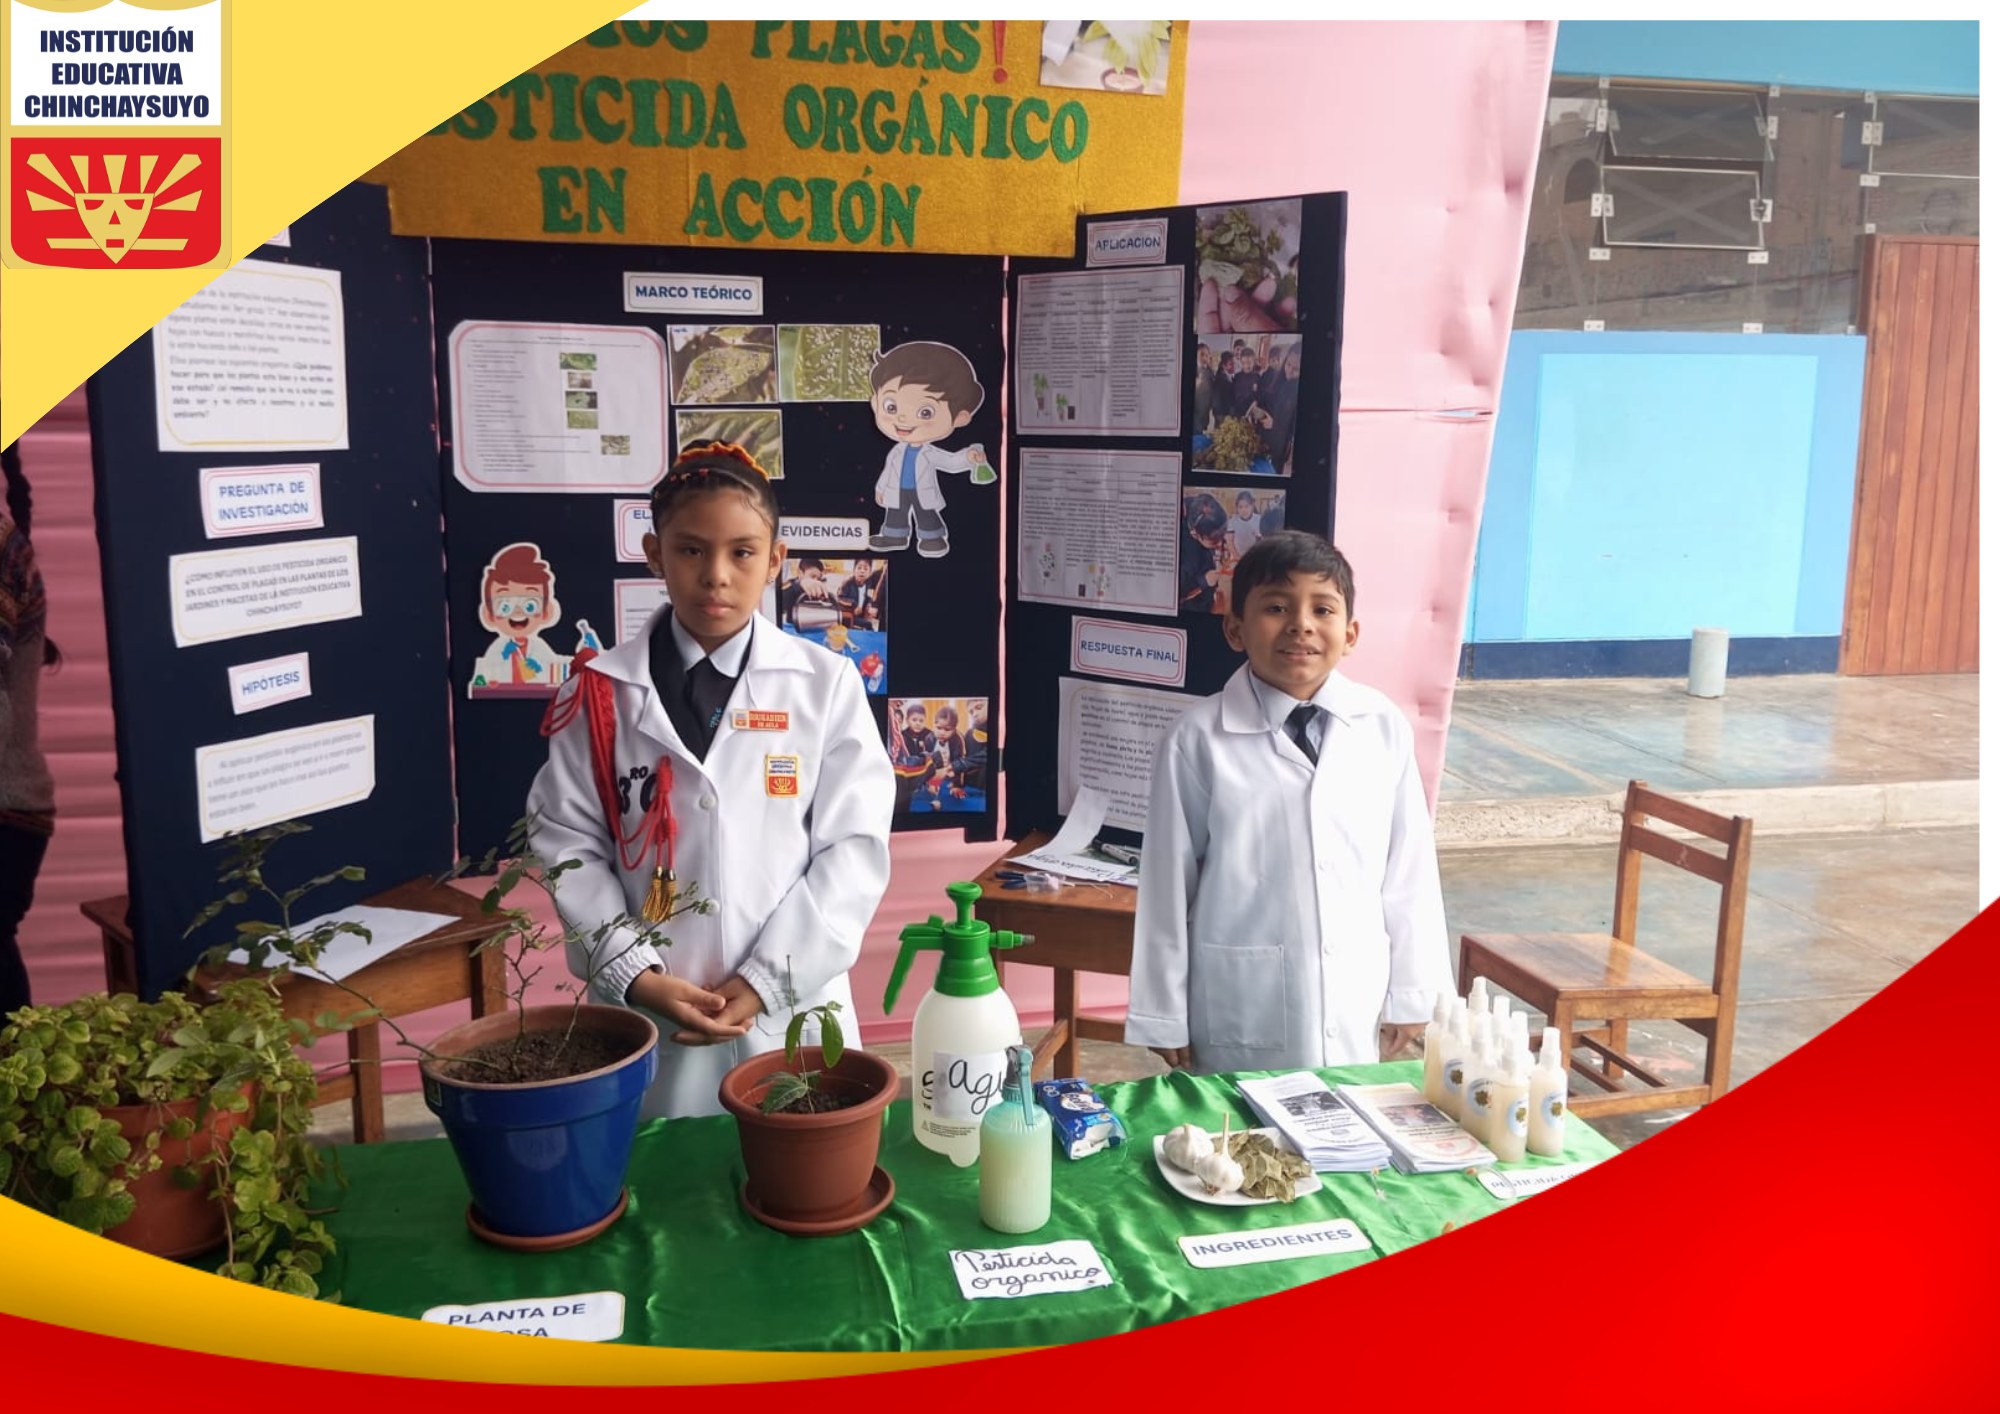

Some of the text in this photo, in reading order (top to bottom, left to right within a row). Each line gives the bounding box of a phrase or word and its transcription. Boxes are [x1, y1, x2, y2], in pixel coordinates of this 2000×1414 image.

[425, 71, 1089, 164] STICIDA ORGÁNICO
[536, 164, 923, 247] EN ACCIÓN
[635, 285, 753, 300] MARCO TEÓRICO
[219, 481, 305, 498] PREGUNTA DE
[218, 501, 309, 520] INVESTIGACIÓN
[781, 525, 863, 538] EVIDENCIAS
[1080, 640, 1179, 662] RESPUESTA FINAL
[242, 670, 300, 696] HIPÓTESIS
[1191, 1228, 1354, 1257] INGREDIENTES
[954, 1251, 1078, 1273] Pesticida
[447, 1303, 586, 1325] PLANTA DE
